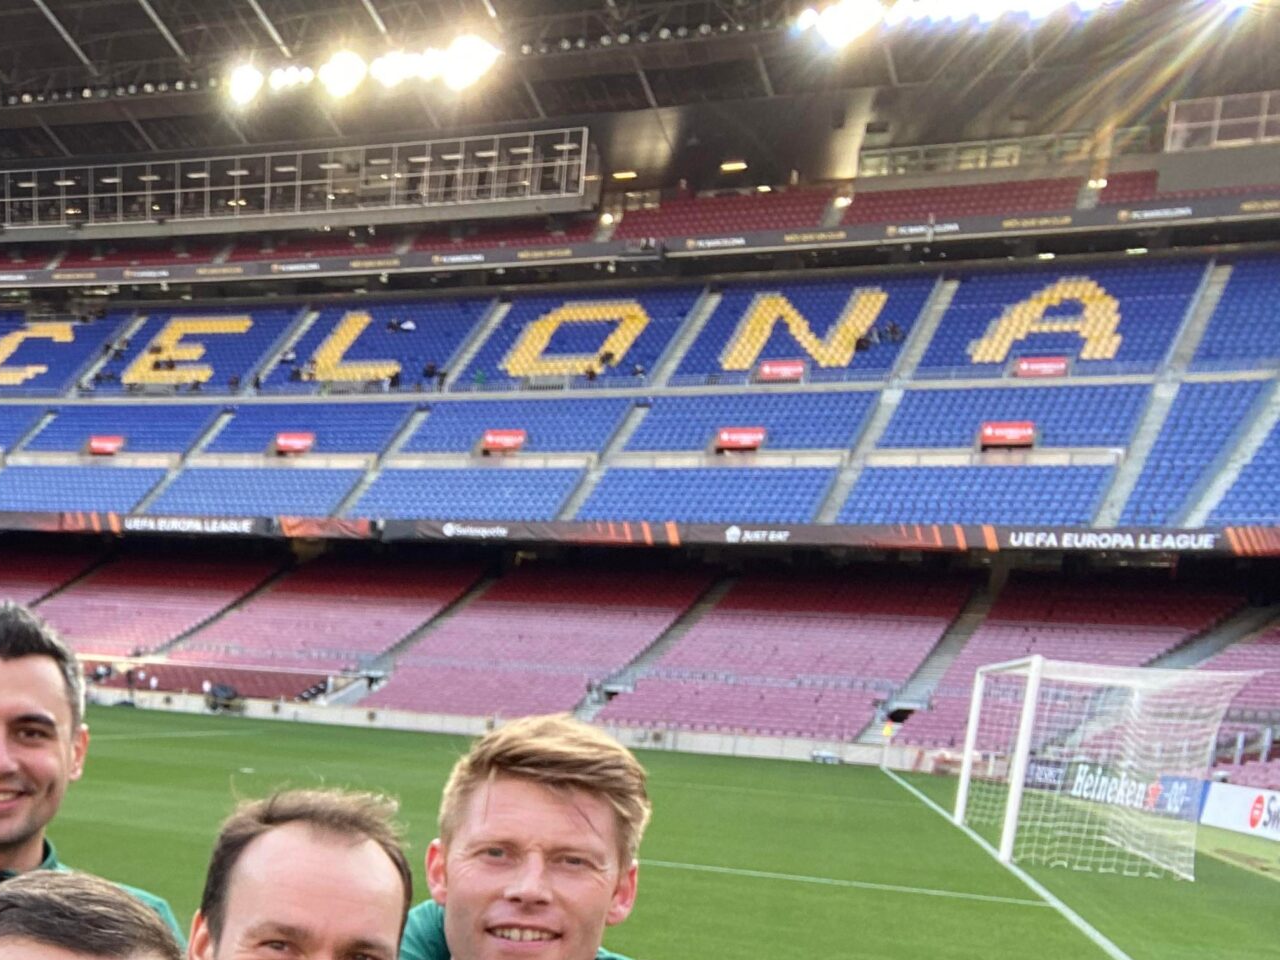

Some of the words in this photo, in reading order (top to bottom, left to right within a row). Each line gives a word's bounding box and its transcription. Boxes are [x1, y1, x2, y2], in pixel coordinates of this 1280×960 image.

[1009, 532, 1058, 547] UEFA
[1062, 533, 1135, 549] EUROPA
[1138, 533, 1216, 549] LEAGUE
[1071, 763, 1148, 810] Heineken
